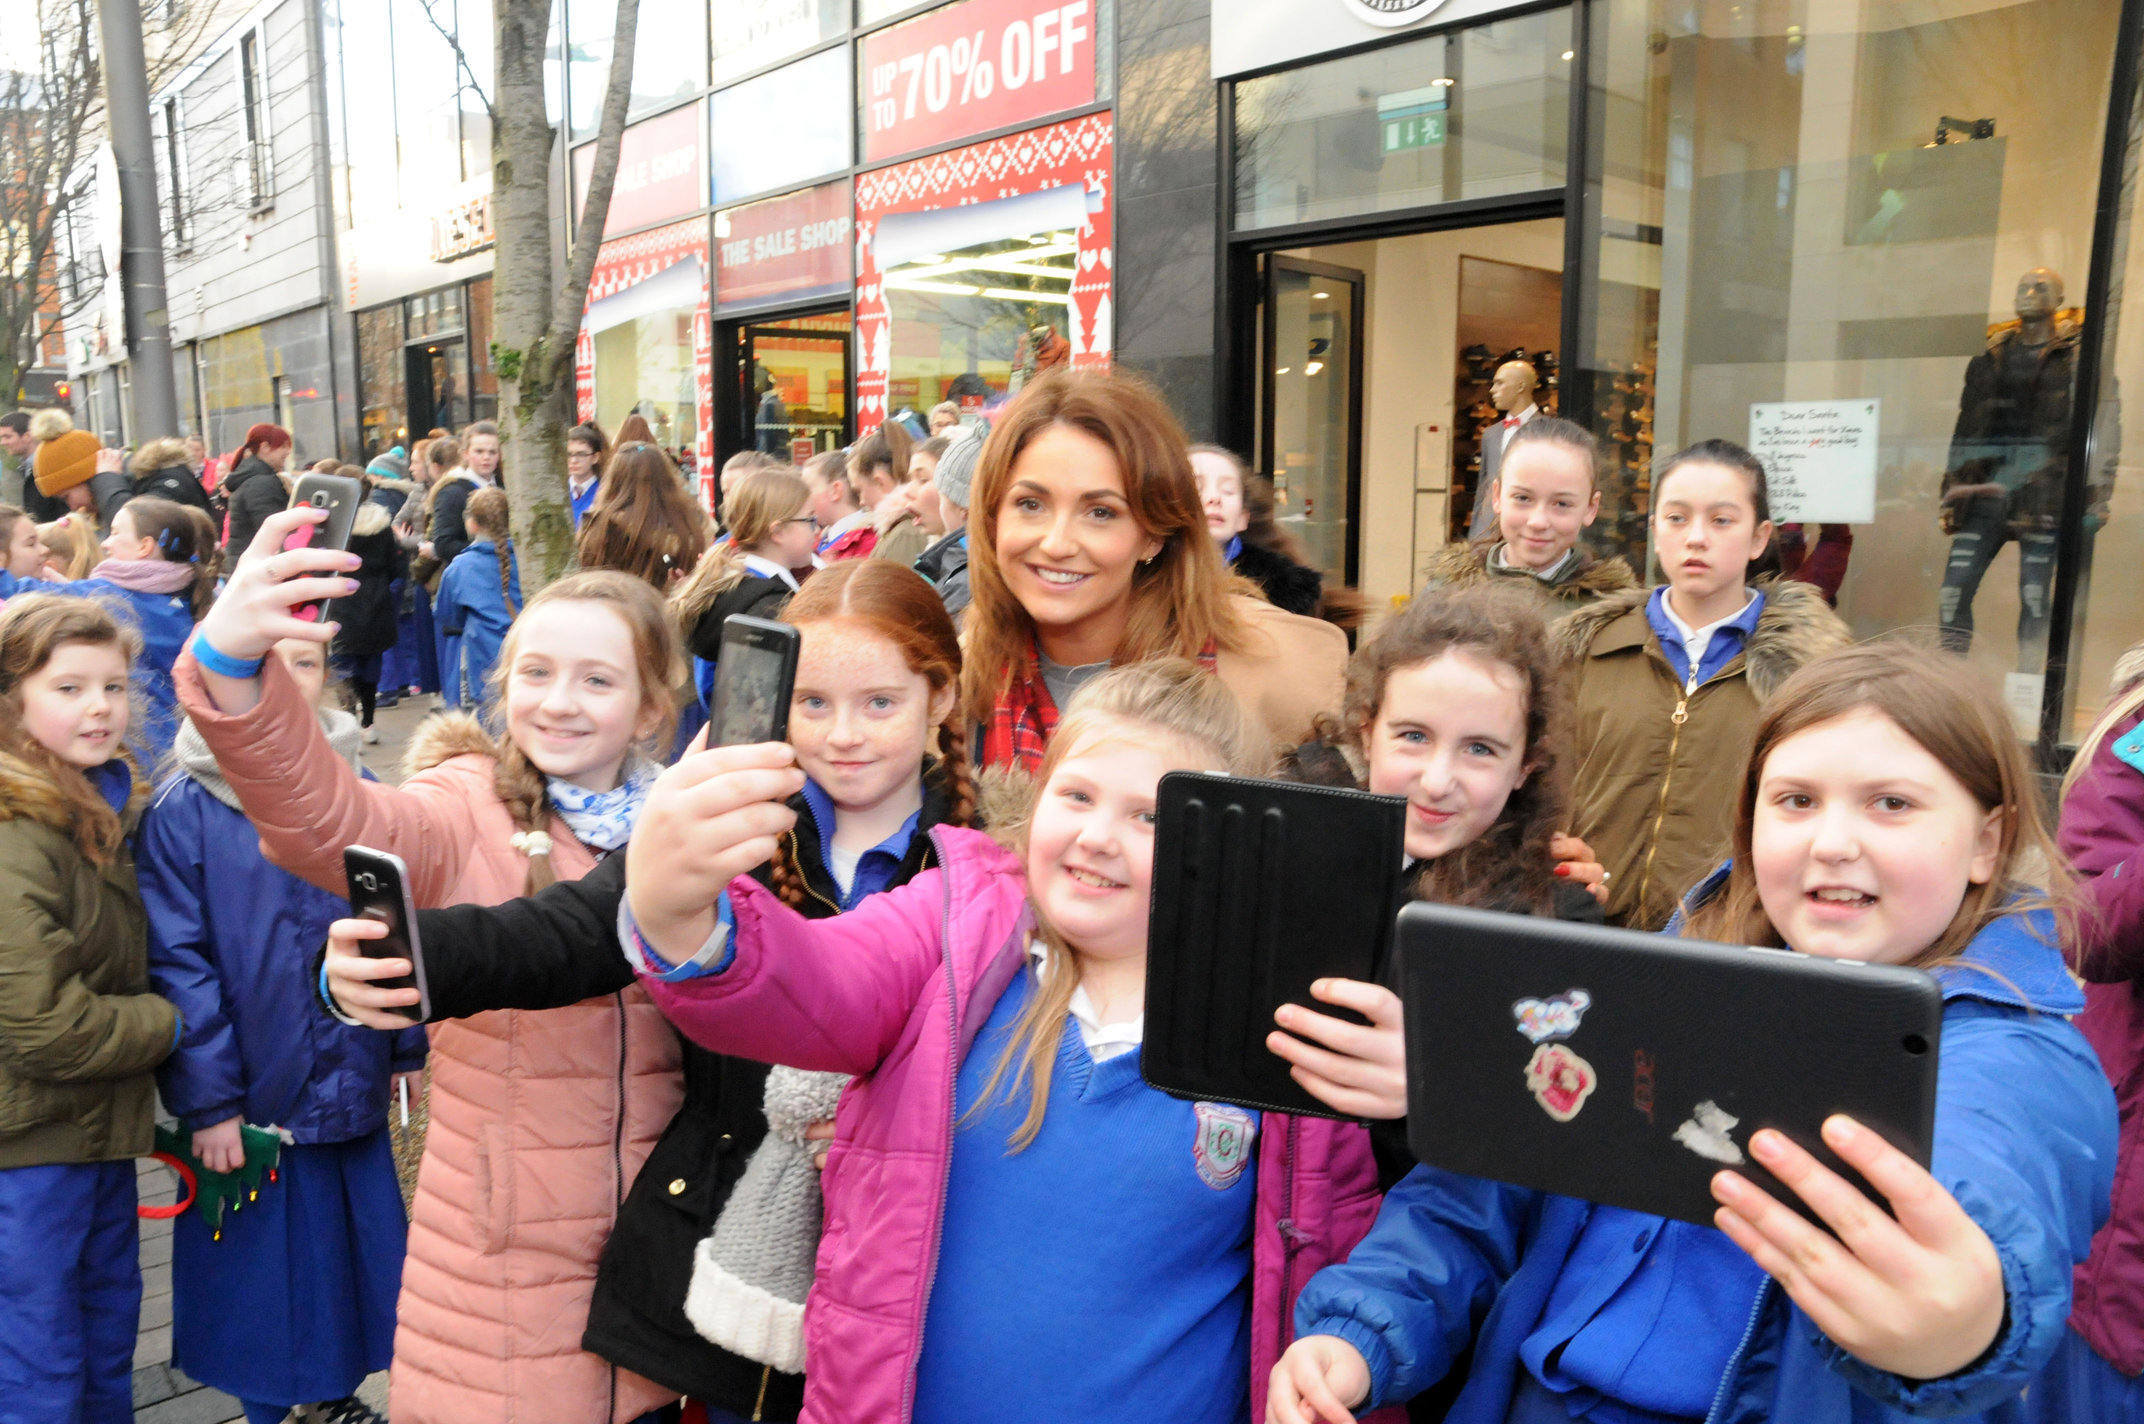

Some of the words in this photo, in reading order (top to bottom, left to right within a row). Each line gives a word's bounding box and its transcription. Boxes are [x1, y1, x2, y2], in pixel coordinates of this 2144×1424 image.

[872, 61, 898, 97] UP
[900, 30, 995, 121] 70%
[1000, 0, 1089, 91] OFF
[872, 98, 897, 132] TO
[722, 238, 751, 268] THE
[754, 228, 797, 261] SALE
[800, 215, 851, 252] SHOP
